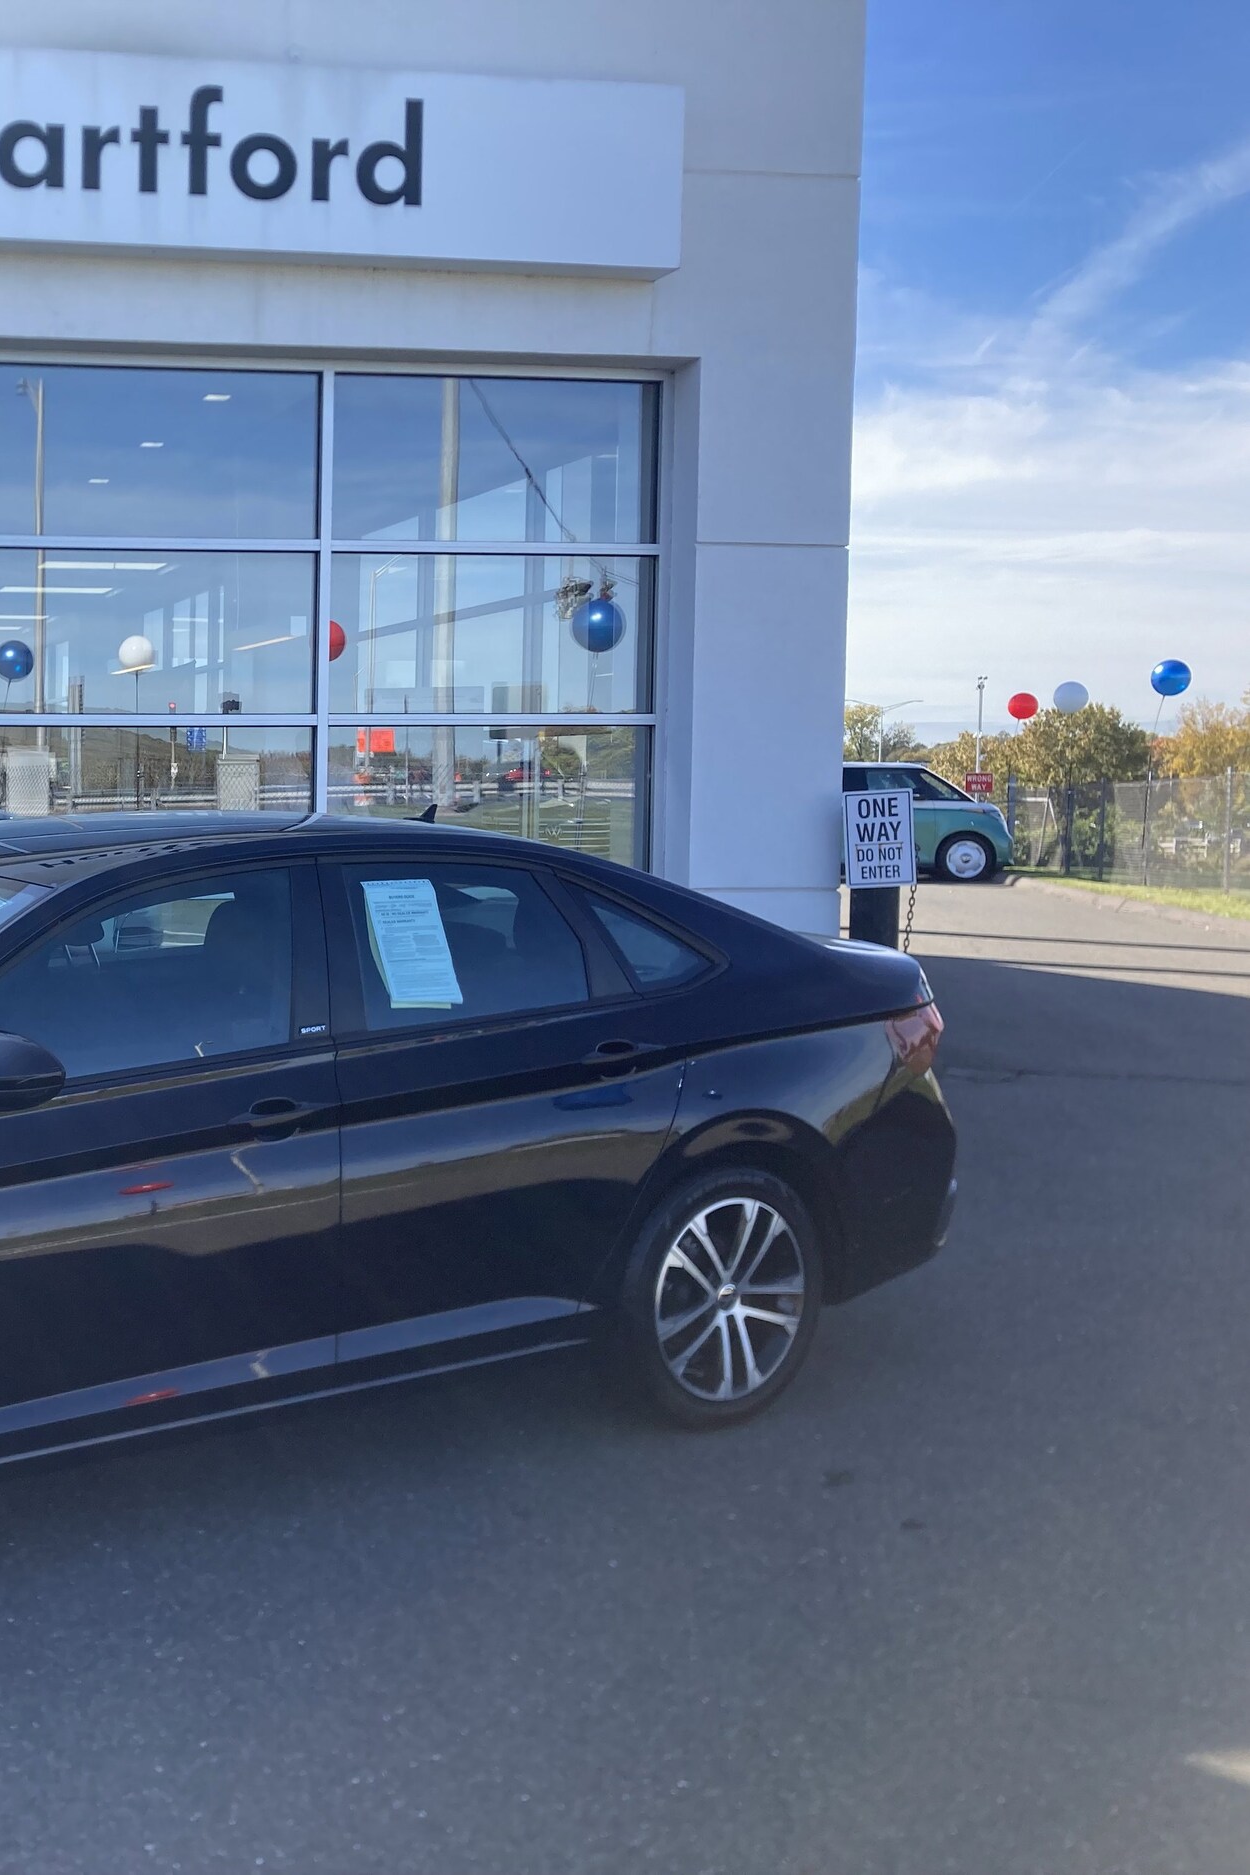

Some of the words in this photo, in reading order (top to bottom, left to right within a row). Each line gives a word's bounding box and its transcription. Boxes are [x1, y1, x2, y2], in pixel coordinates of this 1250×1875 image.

[966, 774, 992, 782] WRONG
[971, 783, 987, 791] WAY
[858, 797, 898, 819] ONE
[856, 821, 902, 842] WAY
[857, 848, 874, 862] DO
[878, 847, 902, 861] NOT
[861, 865, 901, 879] ENTER
[301, 1025, 325, 1033] SPORT
